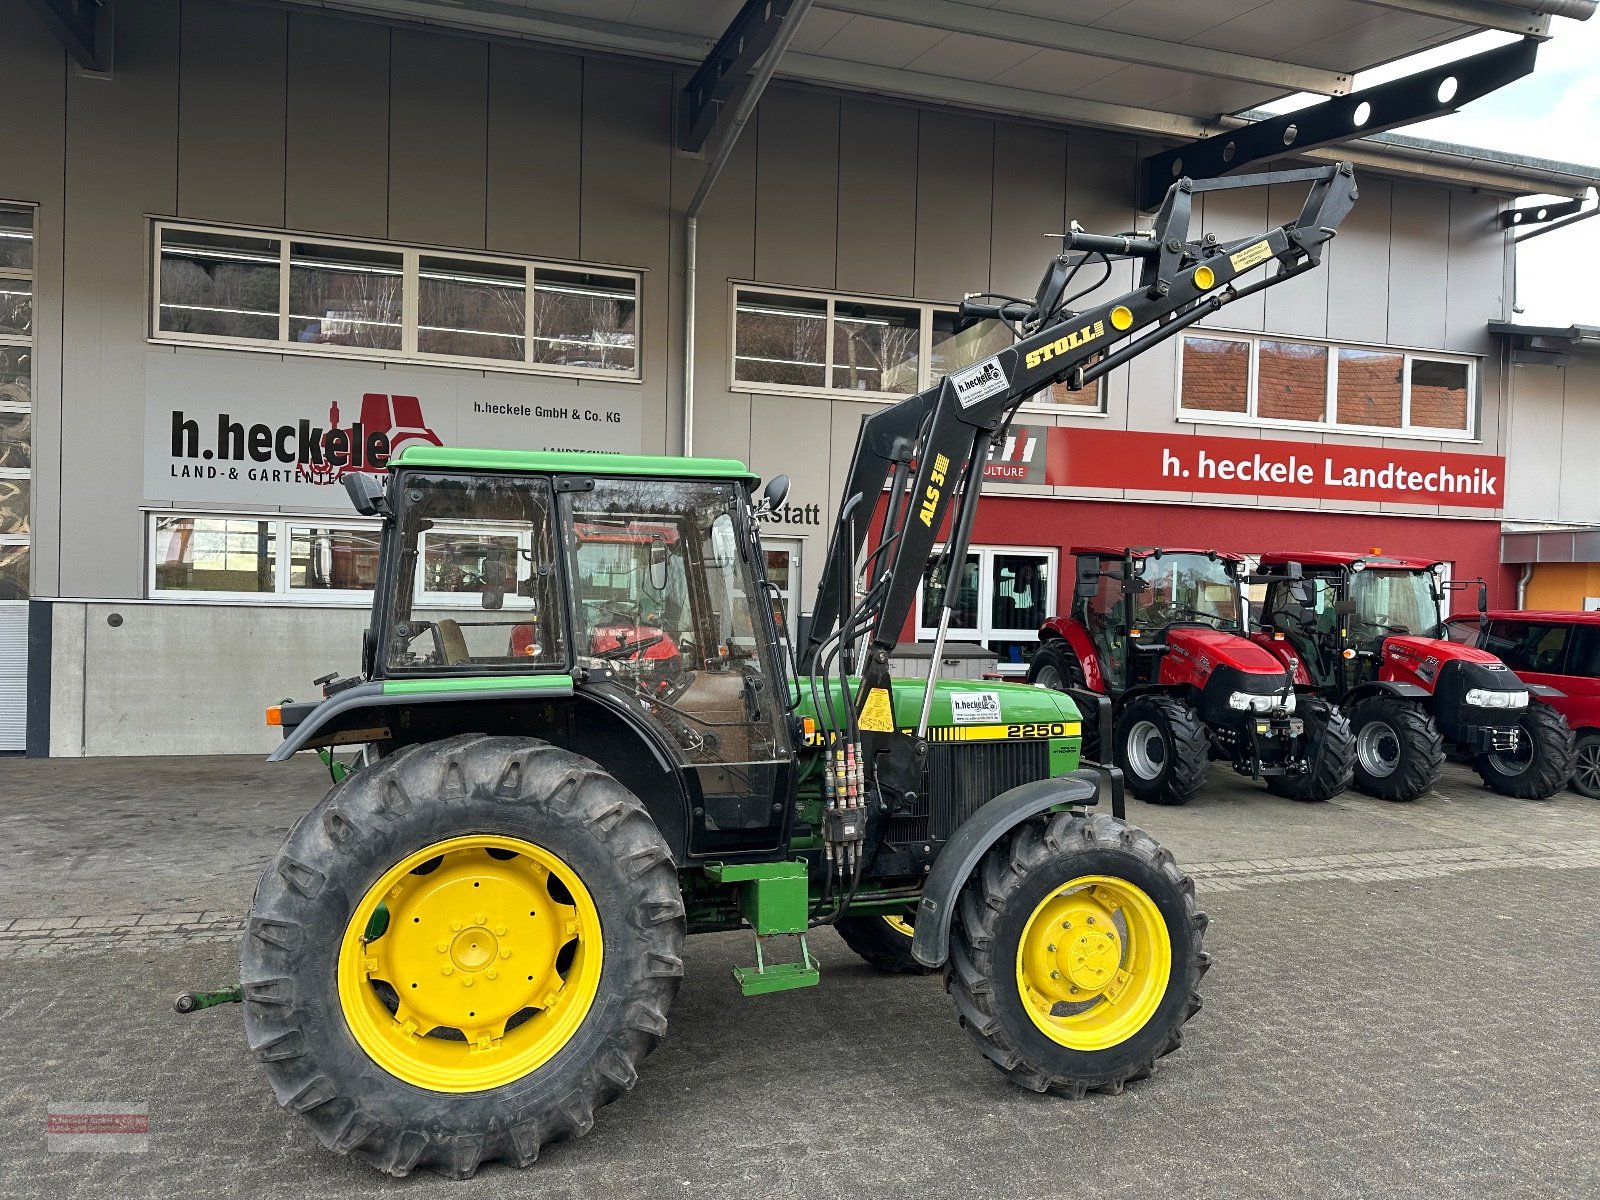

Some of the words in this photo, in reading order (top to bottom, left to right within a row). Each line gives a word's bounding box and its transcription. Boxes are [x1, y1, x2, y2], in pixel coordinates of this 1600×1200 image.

[1025, 324, 1096, 369] STOLL
[474, 401, 531, 416] h.heckele
[535, 406, 568, 419] GmbH
[571, 409, 581, 420] &
[584, 410, 602, 422] Co.
[606, 411, 621, 423] KG
[172, 410, 391, 467] h.heckele
[248, 468, 389, 487] GARTENTECK
[1162, 448, 1189, 479] h.
[1198, 450, 1314, 485] heckele
[1324, 457, 1497, 496] Landtechnik
[918, 485, 941, 527] ALS
[1007, 723, 1065, 738] 2250
